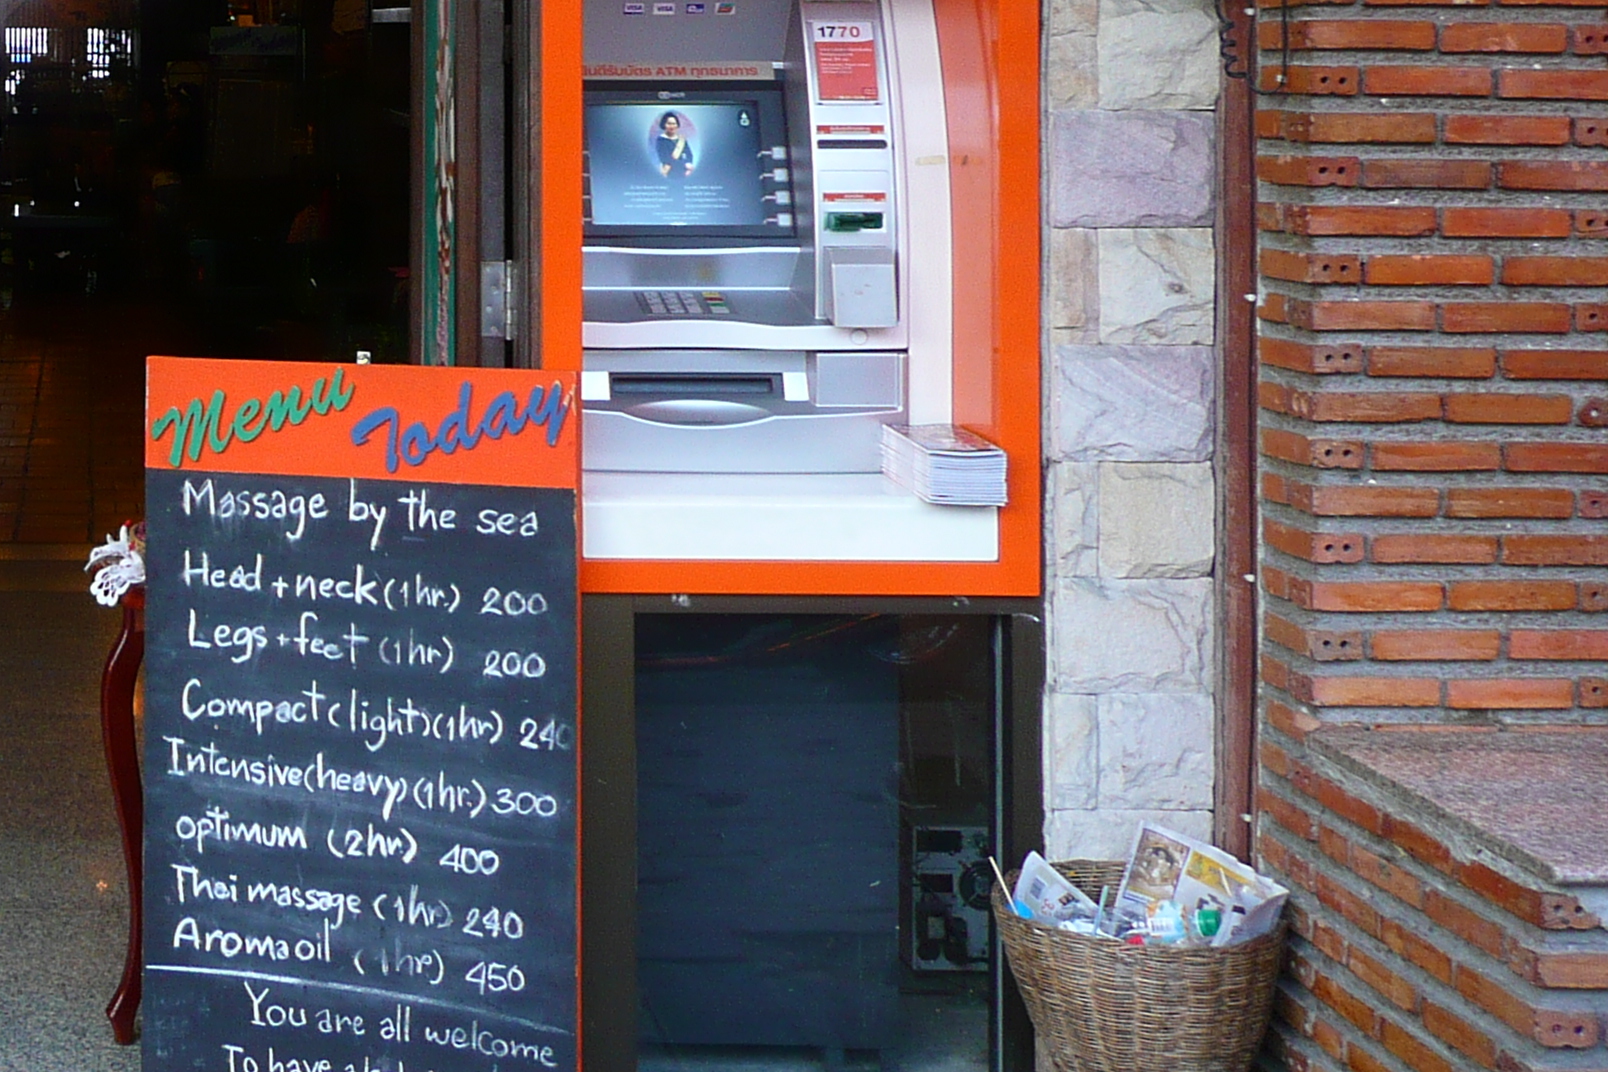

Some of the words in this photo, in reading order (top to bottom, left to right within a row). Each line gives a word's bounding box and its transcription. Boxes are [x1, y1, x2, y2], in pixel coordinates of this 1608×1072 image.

[817, 25, 861, 38] 1770
[656, 66, 687, 77] ATM
[151, 367, 354, 468] Menu
[351, 380, 573, 472] Today
[182, 477, 330, 542] Massage
[348, 477, 387, 551] by
[397, 488, 456, 532] the
[475, 509, 539, 538] sea
[478, 588, 549, 617] 200
[482, 650, 547, 679] 200
[490, 788, 557, 817] 300
[175, 805, 307, 854] optimum
[439, 843, 500, 876] 400
[171, 863, 238, 903] Thai
[247, 882, 362, 929] massage
[462, 905, 524, 939] 240
[464, 963, 526, 995] 450
[243, 980, 306, 1027] You
[314, 1009, 366, 1035] are
[379, 1003, 411, 1043] all
[424, 1020, 559, 1068] welcome
